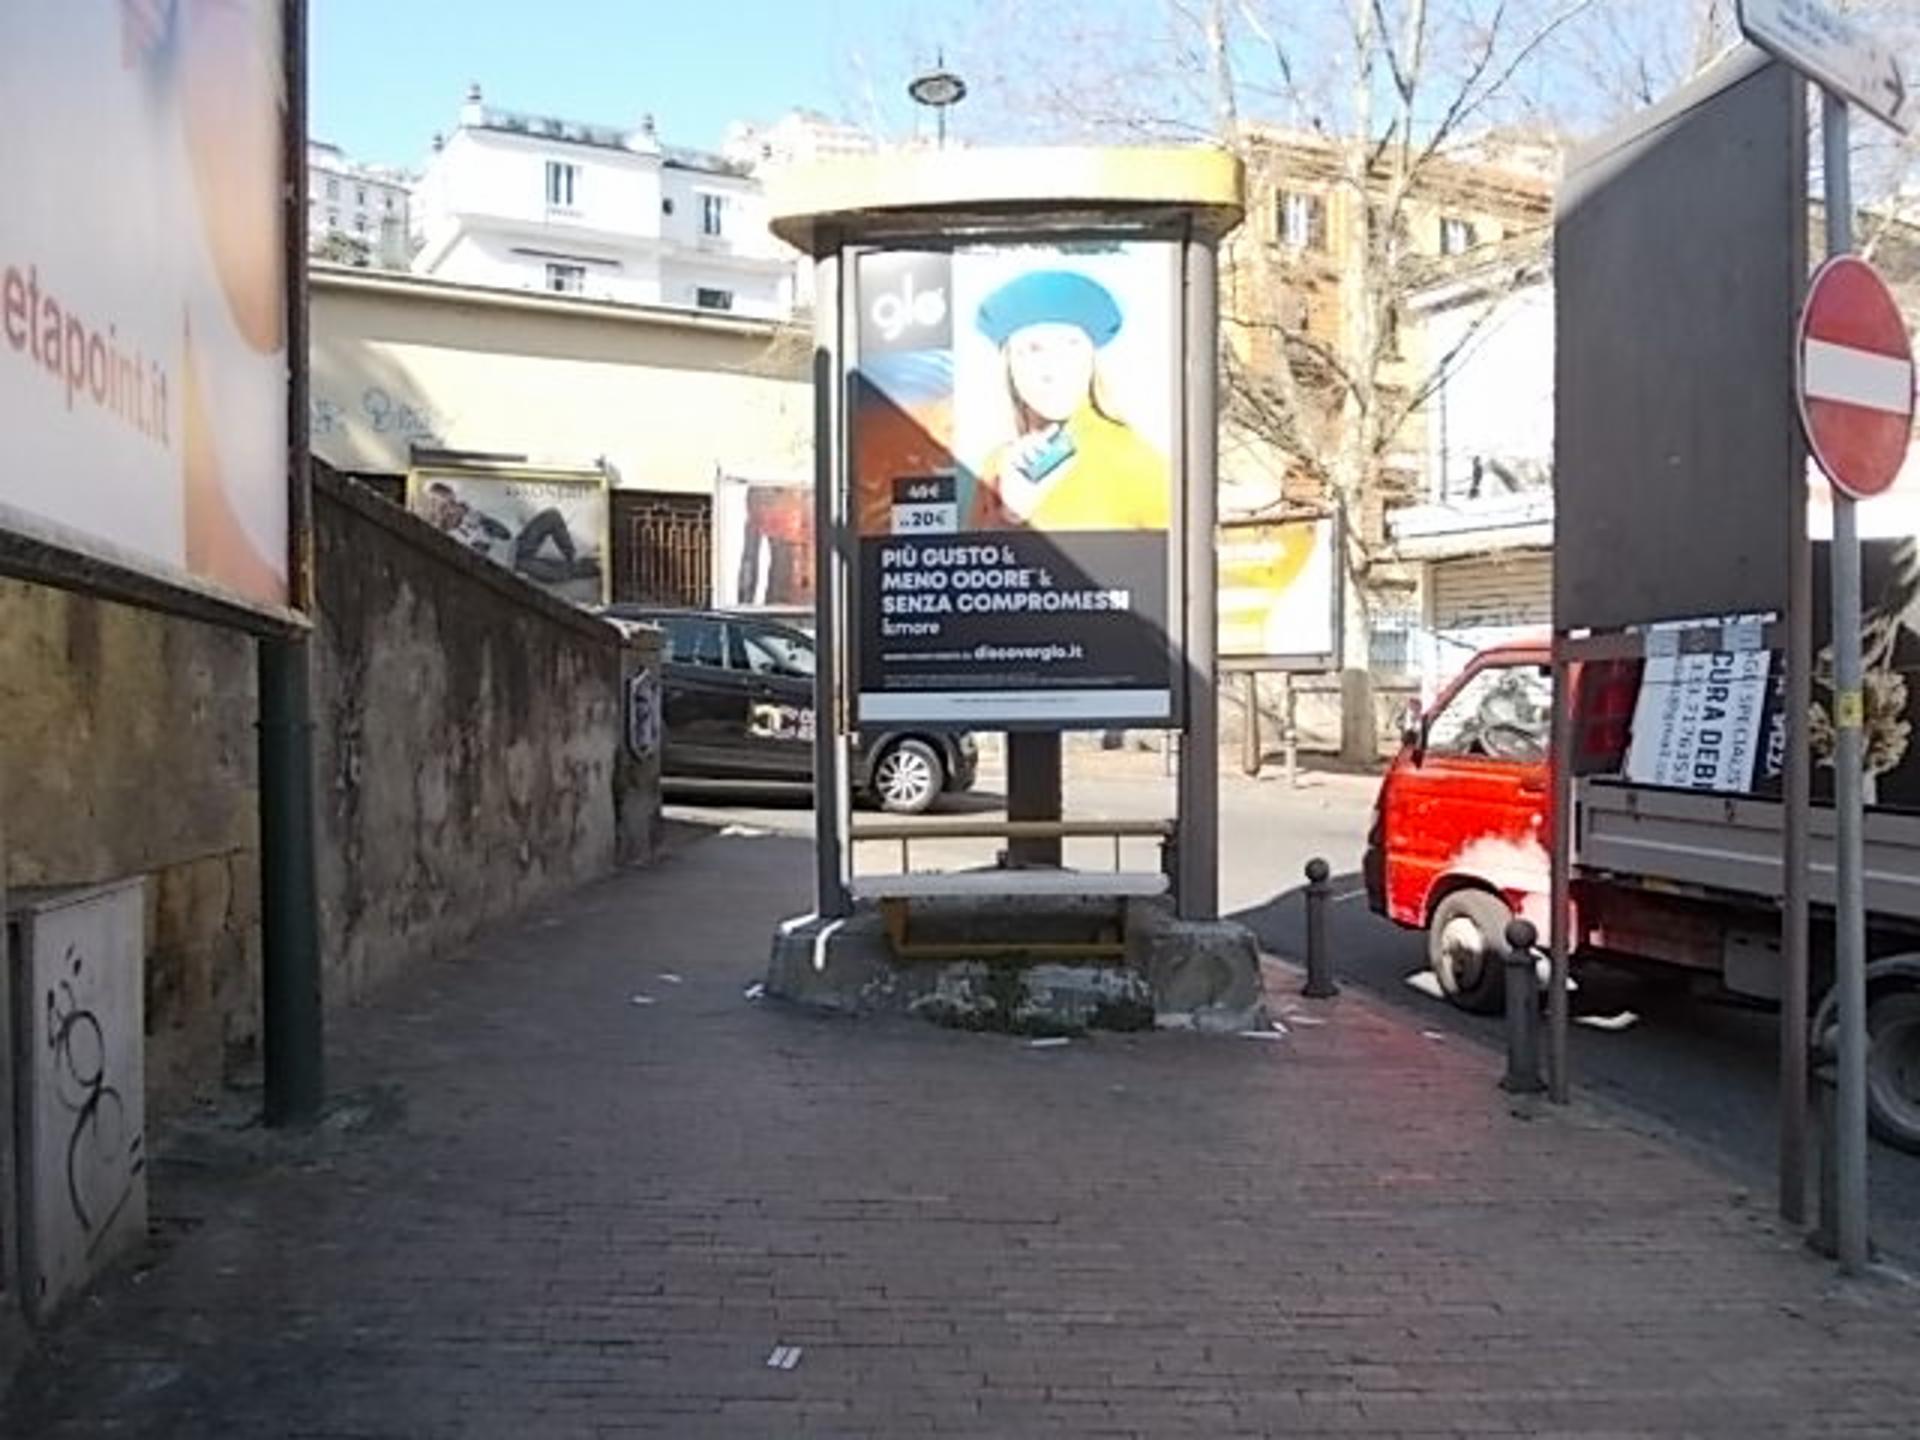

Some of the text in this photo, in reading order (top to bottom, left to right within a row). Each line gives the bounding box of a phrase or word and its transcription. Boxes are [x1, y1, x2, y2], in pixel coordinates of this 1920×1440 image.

[882, 544, 918, 568] PIÙ
[921, 546, 999, 567] GUSTO
[882, 570, 948, 592] MENO
[882, 593, 953, 614] SENZA
[1702, 650, 1735, 721] CURA
